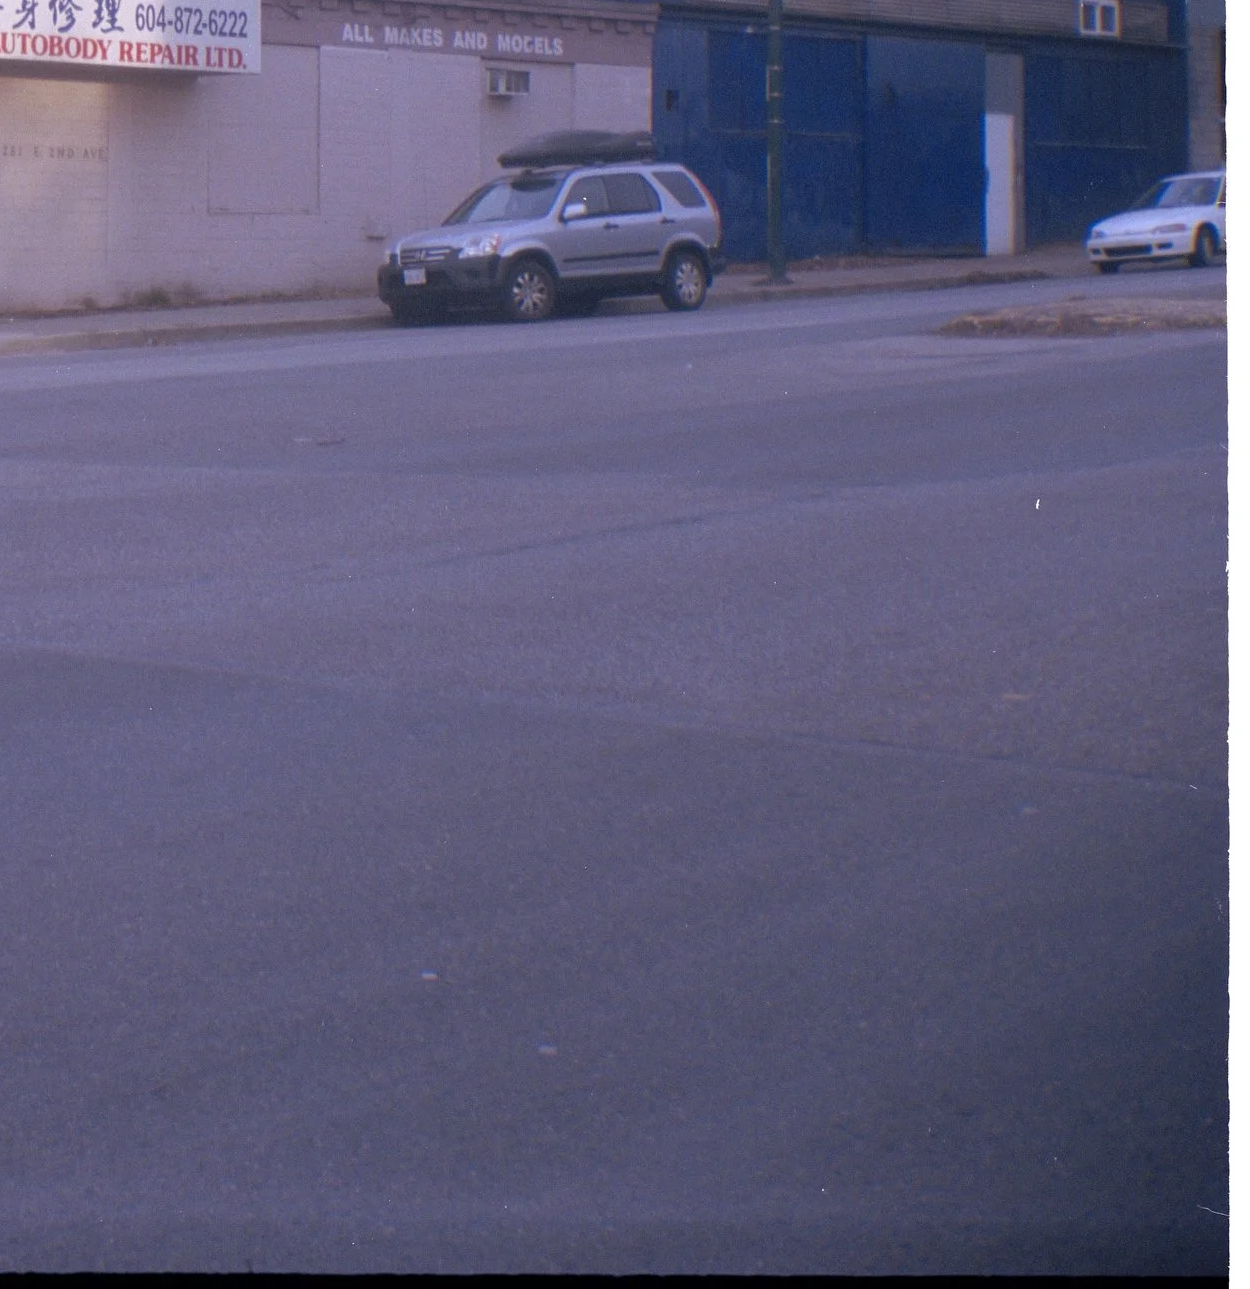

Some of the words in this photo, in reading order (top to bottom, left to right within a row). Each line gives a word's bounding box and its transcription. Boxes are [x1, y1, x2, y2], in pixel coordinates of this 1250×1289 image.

[135, 3, 248, 39] 604-872-6222
[342, 23, 374, 43] ALL
[384, 26, 443, 48] MAKES
[453, 30, 488, 51] AND
[119, 39, 199, 67] REPAIR
[205, 46, 247, 70] LTD.
